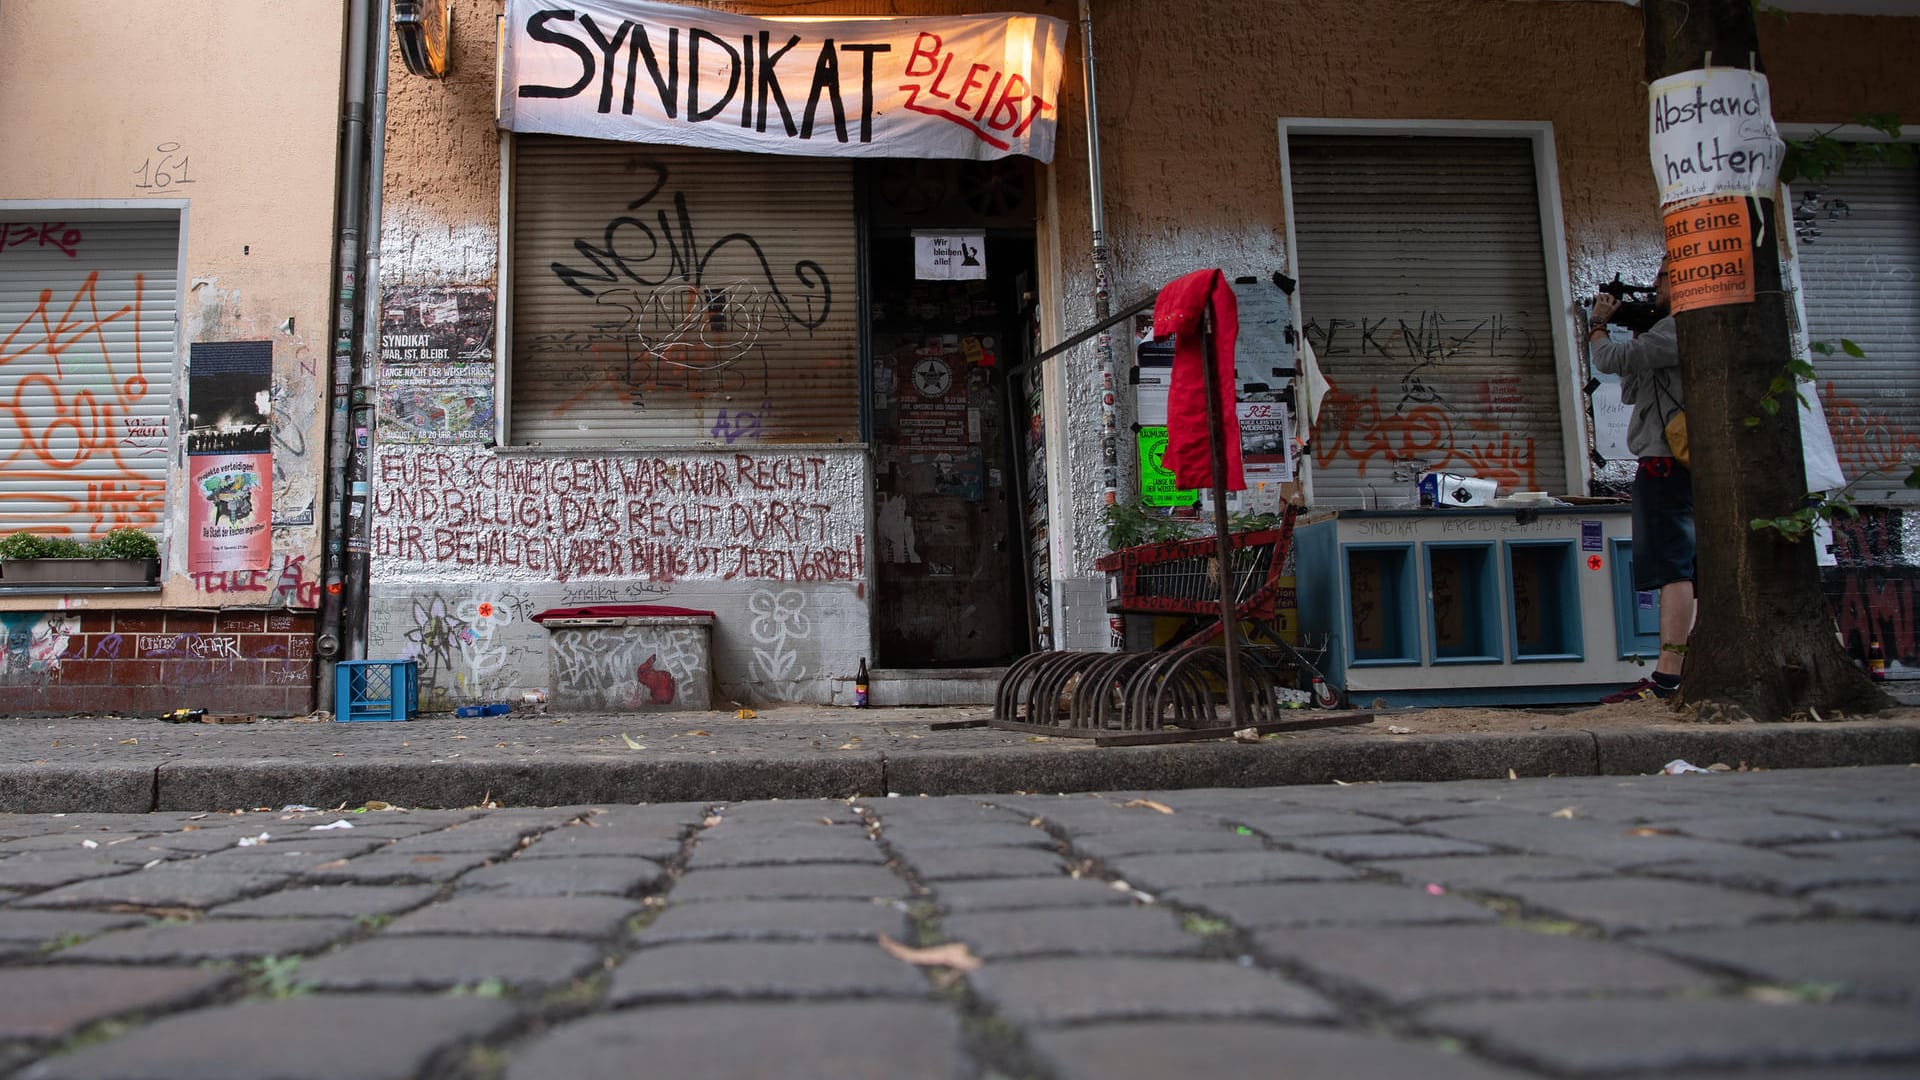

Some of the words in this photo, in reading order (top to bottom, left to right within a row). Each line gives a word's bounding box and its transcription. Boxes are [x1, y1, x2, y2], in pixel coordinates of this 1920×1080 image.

[518, 9, 892, 143] SYNDIKAT
[905, 31, 1054, 138] BLEIBT
[1655, 84, 1761, 134] Abstand
[133, 154, 195, 189] 161
[1695, 212, 1740, 230] eine
[933, 238, 947, 247] Wir
[933, 248, 962, 257] bleiben
[1708, 237, 1742, 252] um
[933, 258, 952, 266] alle!
[1669, 258, 1743, 285] Europa!
[381, 334, 431, 348] SYNDIKAT
[420, 348, 450, 360] BLEIBT.
[382, 367, 403, 378] LANGE
[404, 367, 427, 378] NACHT
[428, 367, 443, 378] DER
[197, 467, 220, 482] Projekte
[380, 454, 457, 488] EUER
[463, 456, 608, 496] SCHWEIGEN
[618, 458, 675, 498] WAR
[680, 460, 733, 498] NUR
[735, 454, 826, 493] RECHT
[374, 487, 440, 521] UND
[561, 496, 620, 536] DAS
[628, 499, 720, 540] RECHT
[730, 500, 831, 542] DÜRFT
[375, 525, 427, 562] IHR
[560, 584, 622, 606] Syndikat
